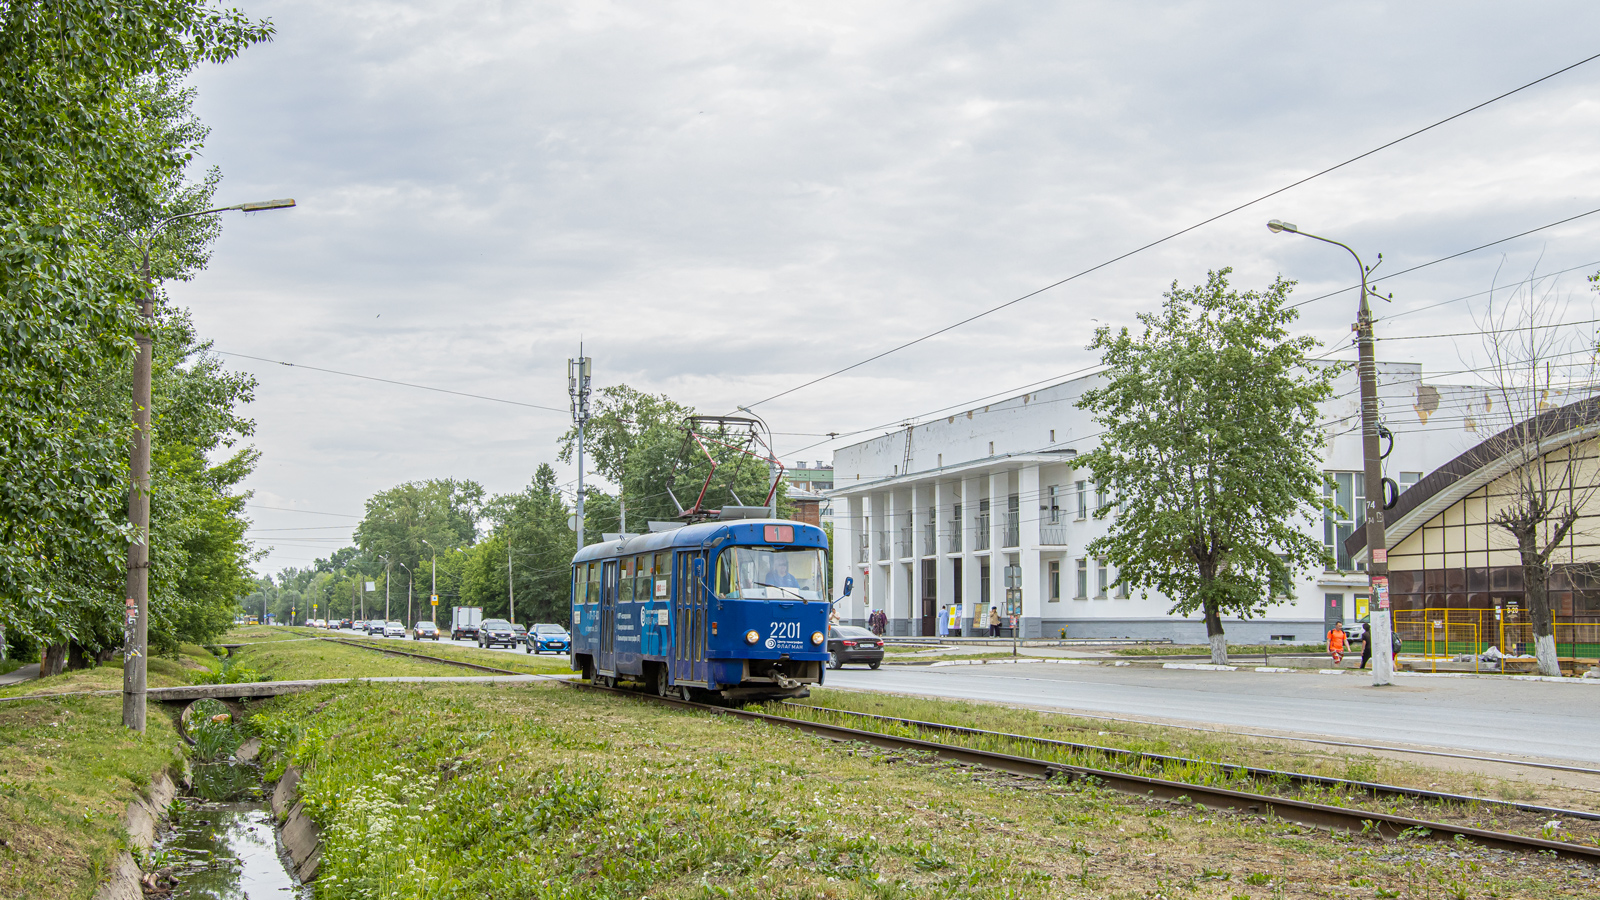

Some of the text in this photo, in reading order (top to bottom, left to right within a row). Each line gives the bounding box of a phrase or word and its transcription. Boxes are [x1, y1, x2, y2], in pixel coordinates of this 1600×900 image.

[1366, 500, 1376, 510] 74
[773, 526, 780, 541] 1
[769, 621, 801, 639] 2201
